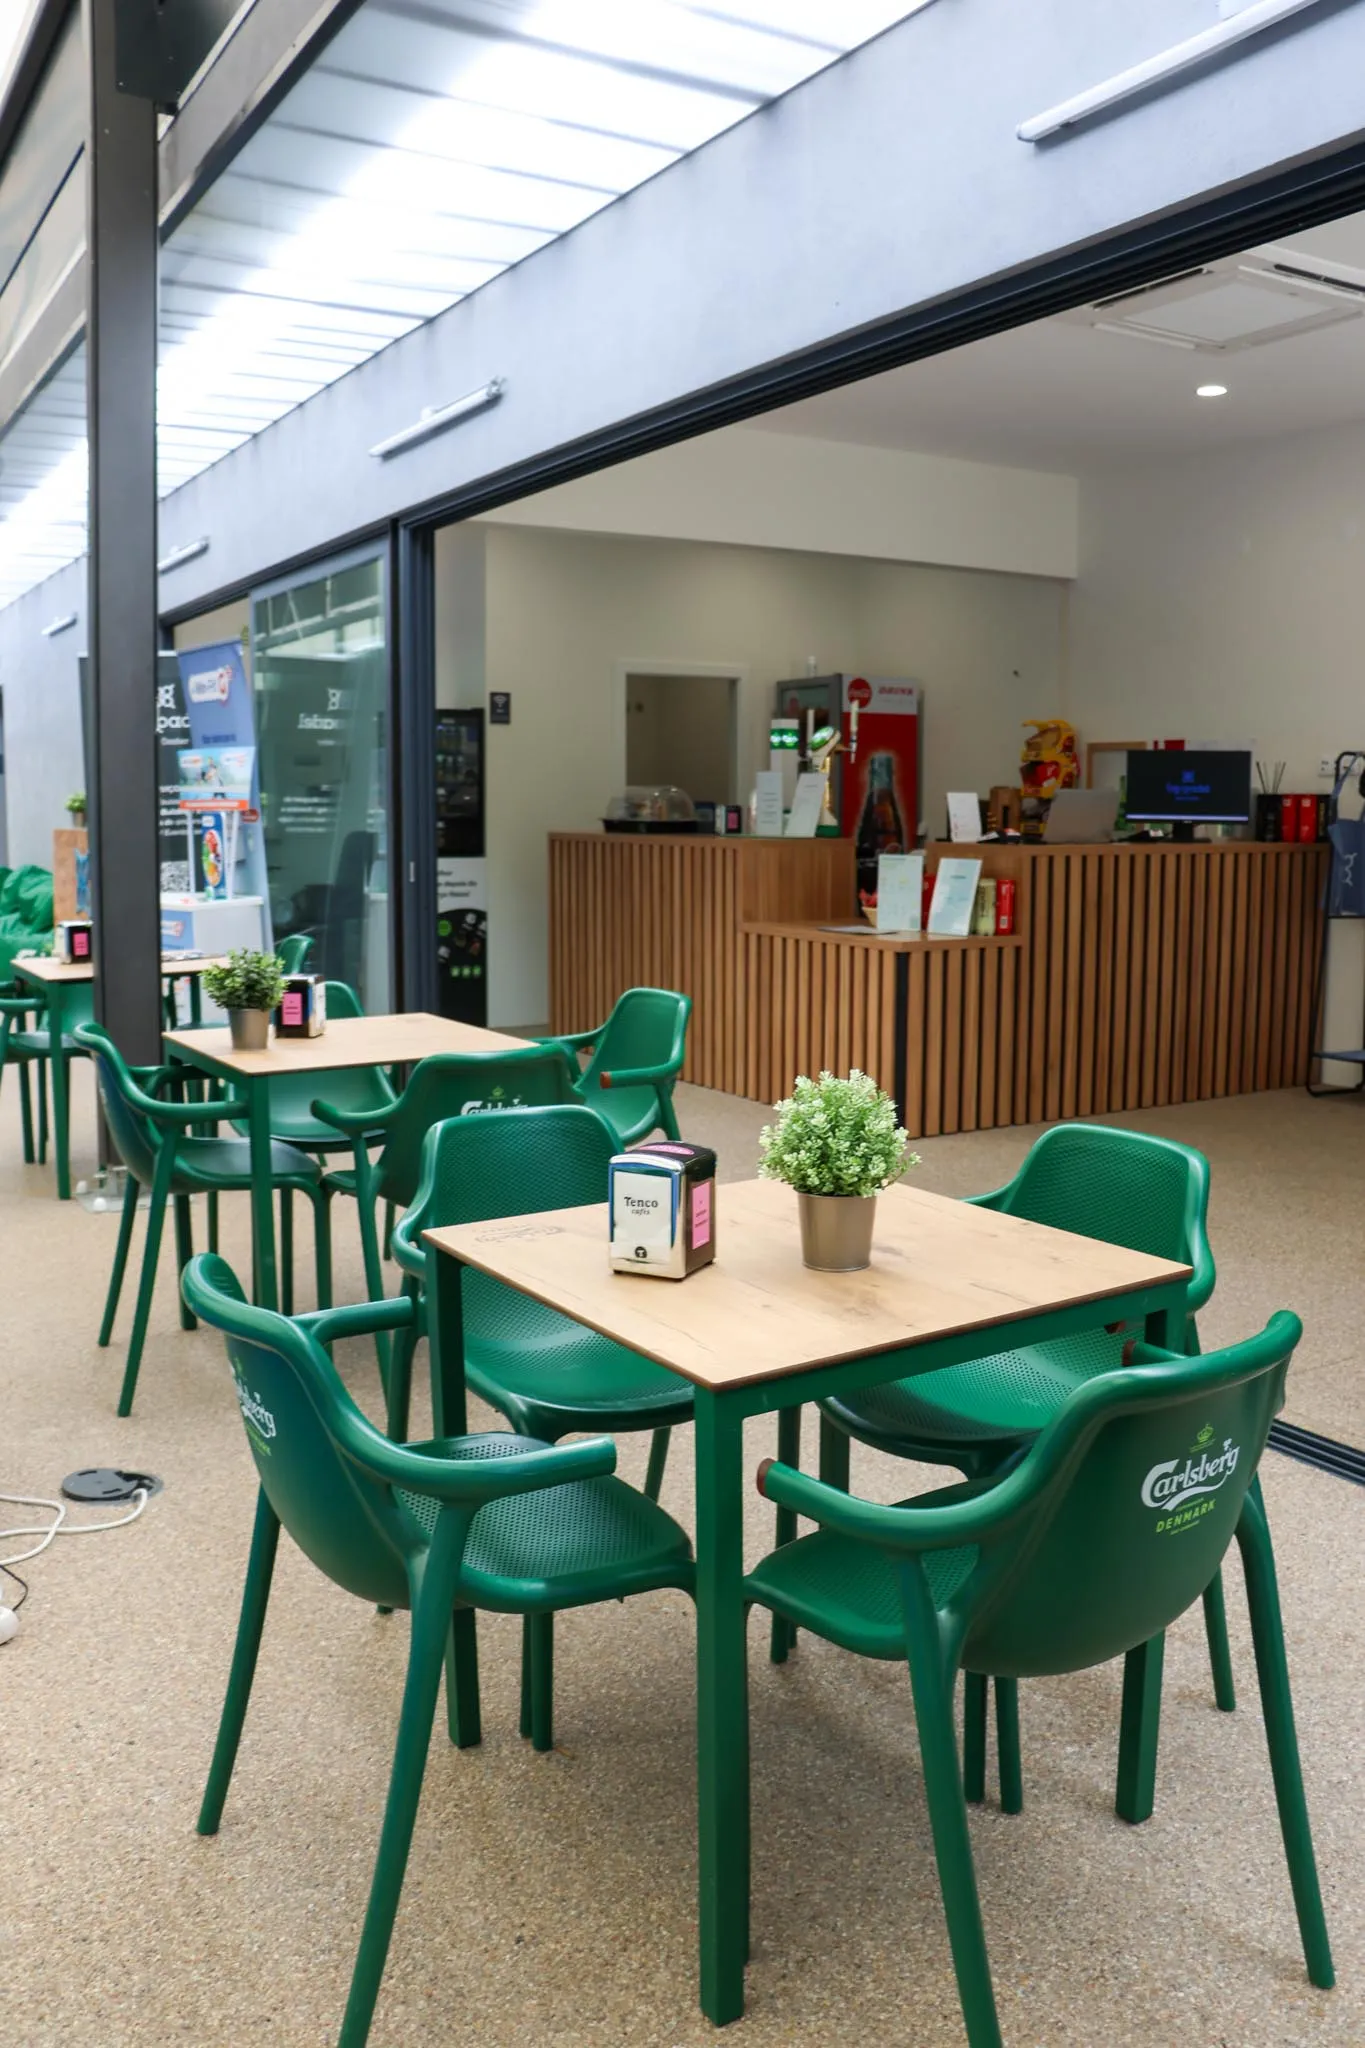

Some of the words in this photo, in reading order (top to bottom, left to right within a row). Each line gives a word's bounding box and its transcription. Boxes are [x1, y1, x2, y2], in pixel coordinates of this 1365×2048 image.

[623, 1196, 659, 1208] Tenco
[1140, 1440, 1241, 1511] Carlsberg
[1155, 1499, 1217, 1533] DENMARK
